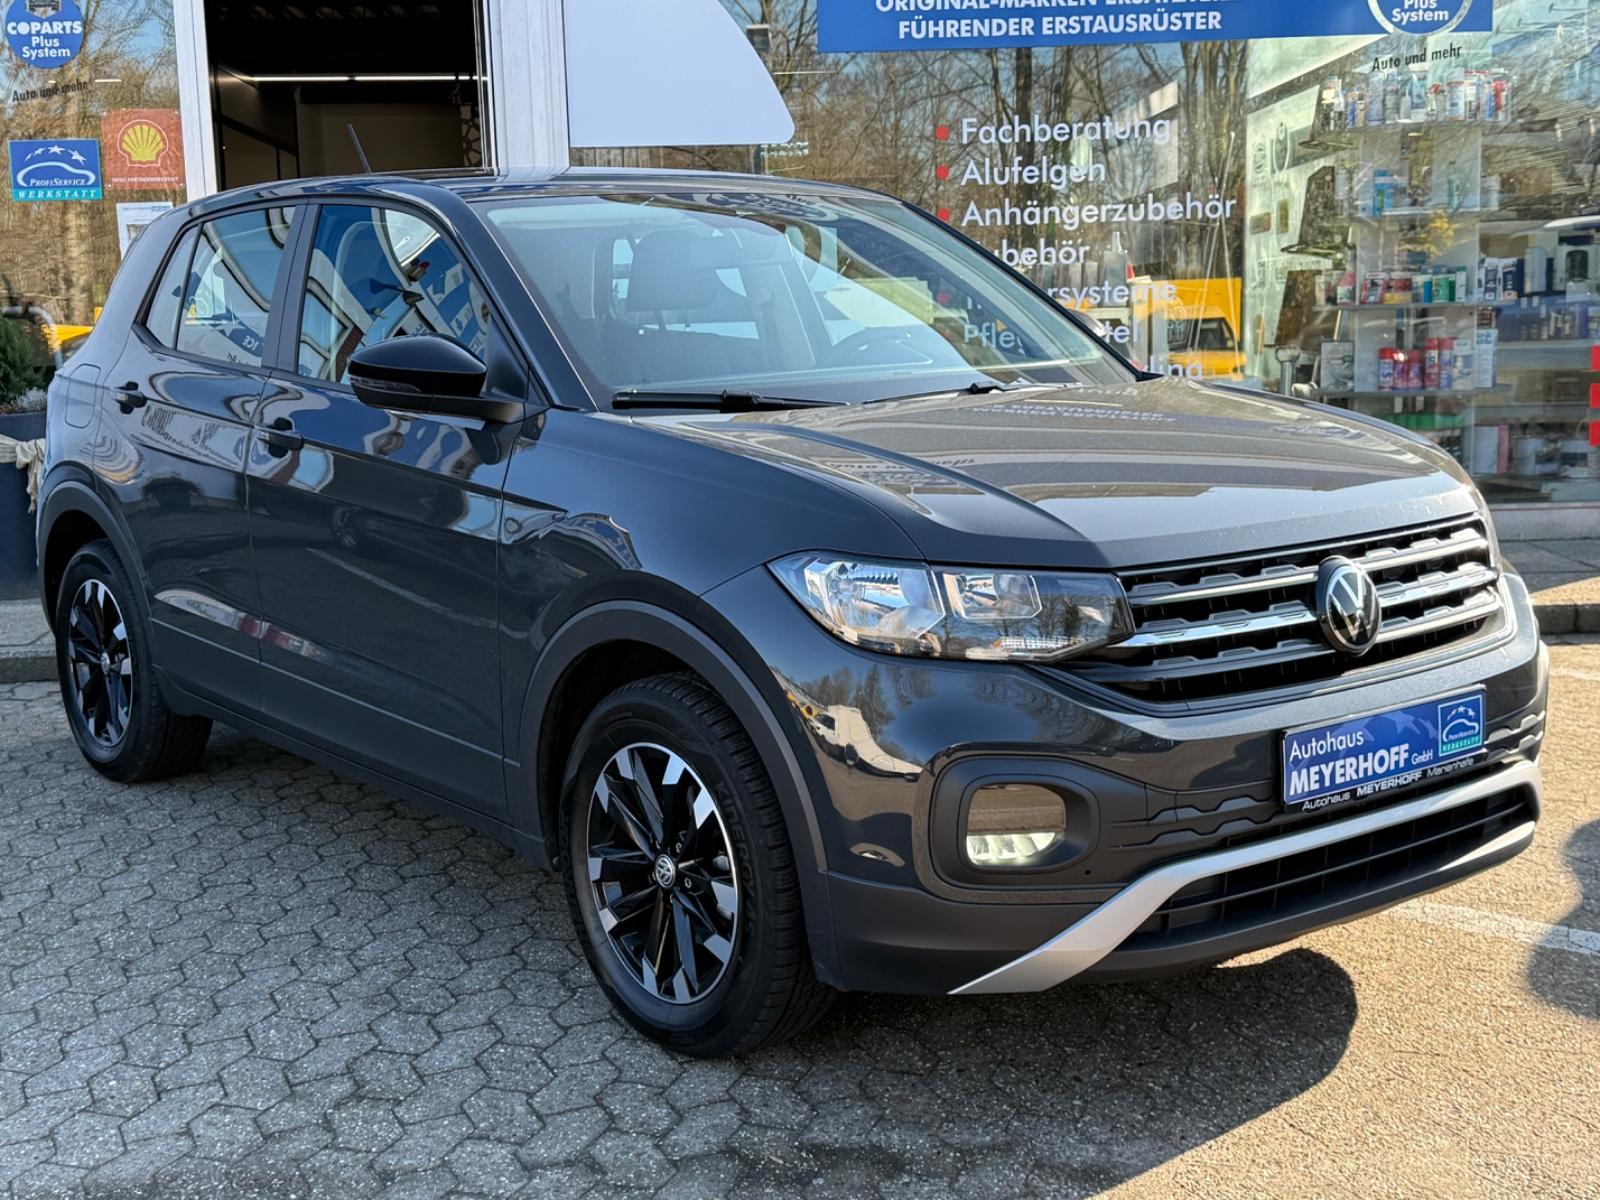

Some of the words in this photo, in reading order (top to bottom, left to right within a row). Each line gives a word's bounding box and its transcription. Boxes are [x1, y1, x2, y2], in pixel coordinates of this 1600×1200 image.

[7, 20, 82, 35] COPARTS
[899, 15, 1035, 39] FÜHRENDER
[1041, 7, 1223, 35] ERSTAUSRÜSTER
[1391, 8, 1449, 25] System
[22, 46, 71, 60] System
[31, 35, 60, 47] Plus
[1371, 56, 1400, 72] Auto
[1405, 48, 1427, 66] und
[1431, 42, 1462, 61] mehr
[12, 89, 37, 103] Auto
[40, 83, 58, 98] und
[61, 79, 87, 94] mehr
[960, 115, 1171, 146] Fachberatung
[960, 156, 1106, 190] Alufelgen
[18, 189, 97, 199] WERKSTATT
[960, 193, 1237, 230] Anhängerzubehör
[993, 238, 1090, 267] behör
[1289, 731, 1365, 763] Autohaus
[1289, 743, 1410, 796] MEYERHOFF
[1412, 749, 1434, 766] GmbH
[1302, 791, 1350, 811] Autohaus
[1356, 771, 1423, 798] MEYERHOFF
[1427, 757, 1474, 778] Marienhafe
